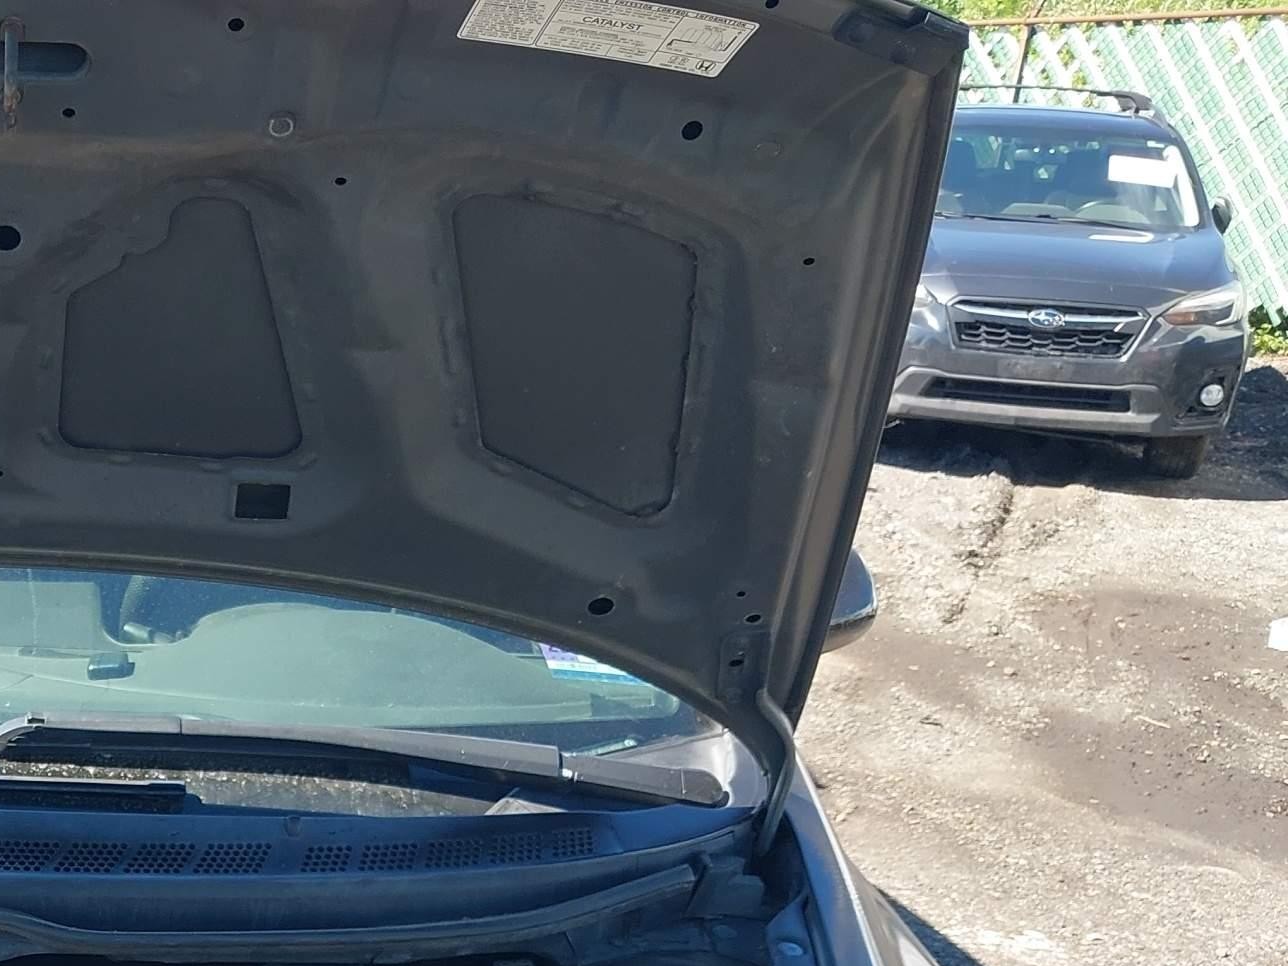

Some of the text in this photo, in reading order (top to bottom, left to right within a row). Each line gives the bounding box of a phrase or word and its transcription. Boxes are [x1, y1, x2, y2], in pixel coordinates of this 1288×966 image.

[582, 16, 643, 31] CATALYST
[656, 6, 689, 17] CONTROL
[695, 13, 748, 27] INFORMATION
